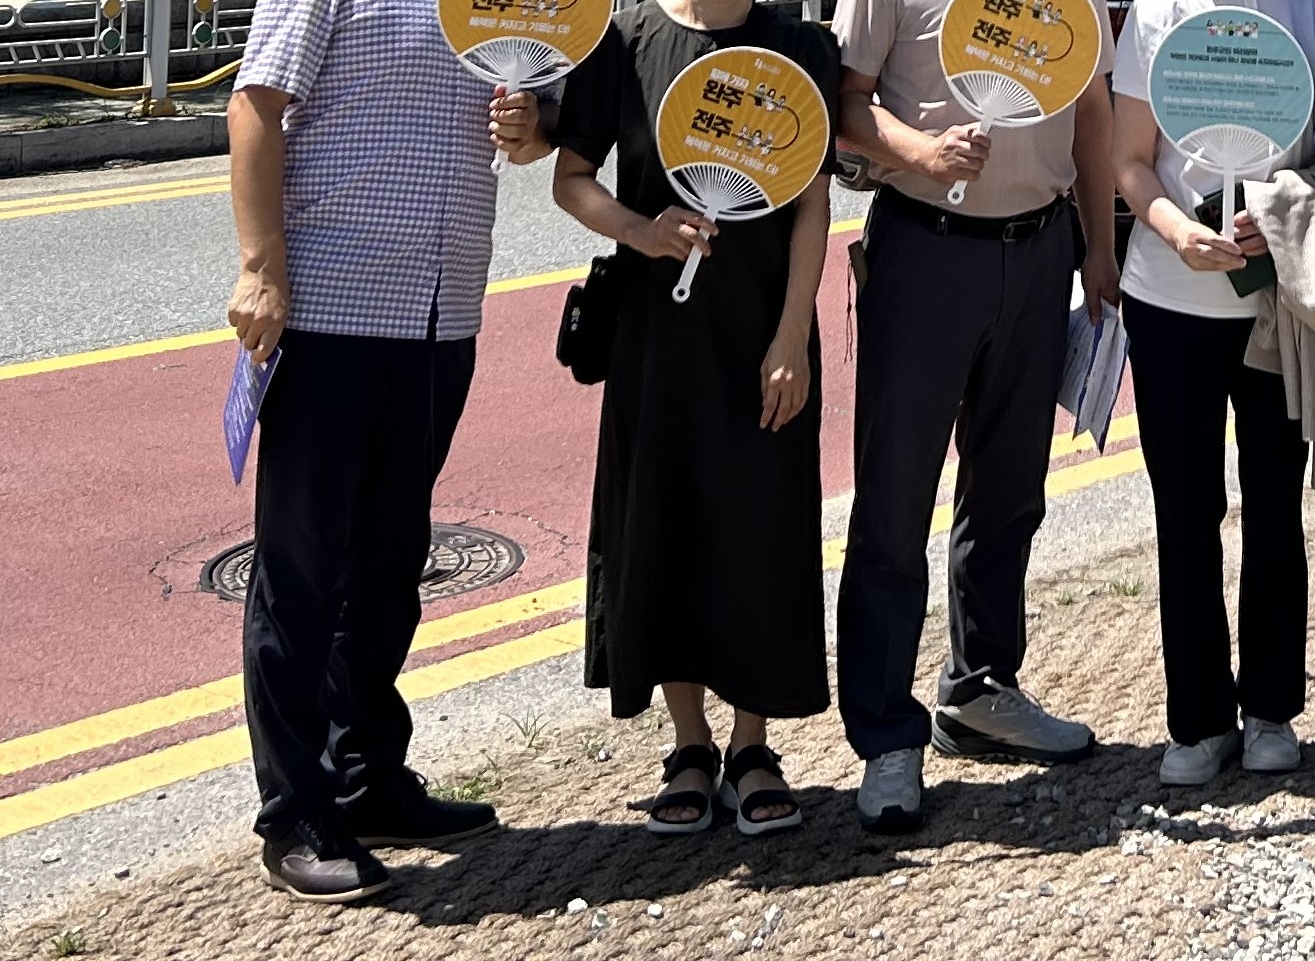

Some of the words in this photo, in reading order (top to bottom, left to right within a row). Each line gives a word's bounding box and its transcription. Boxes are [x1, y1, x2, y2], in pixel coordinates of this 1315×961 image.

[971, 18, 1012, 48] 전주
[702, 79, 744, 109] 완주
[691, 107, 734, 138] 전주
